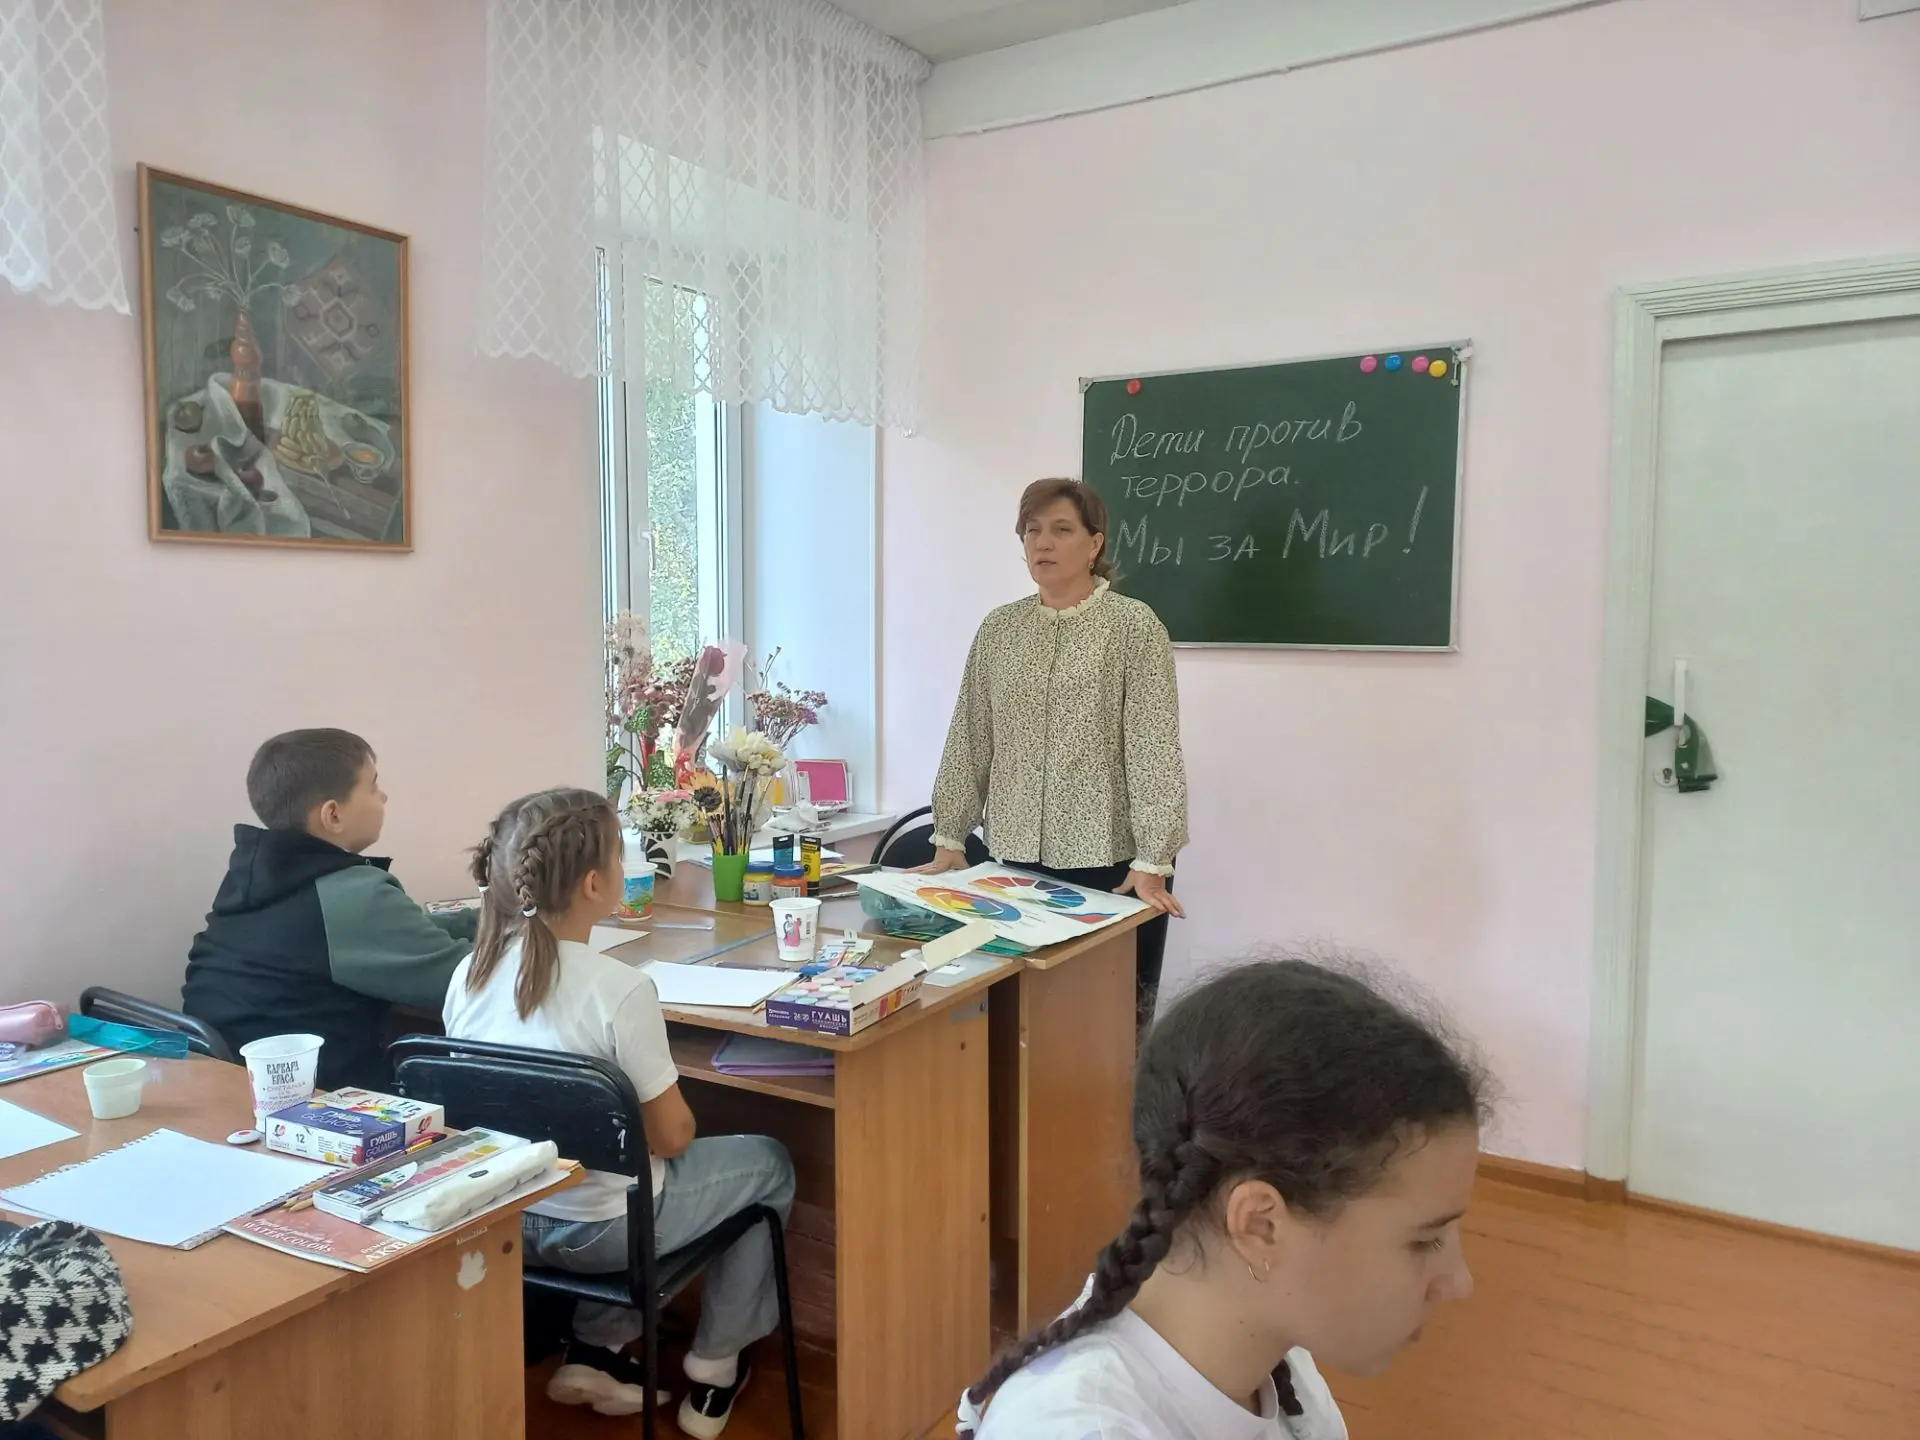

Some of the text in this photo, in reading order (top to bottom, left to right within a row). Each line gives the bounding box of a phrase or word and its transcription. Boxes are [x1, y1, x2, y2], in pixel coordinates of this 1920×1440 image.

[1110, 400, 1363, 465] Дети против
[1113, 514, 1185, 569] Мы
[811, 1010, 847, 1023] ГУАШЬ
[295, 1133, 306, 1144] 12
[370, 1131, 398, 1147] ГУАШЬ
